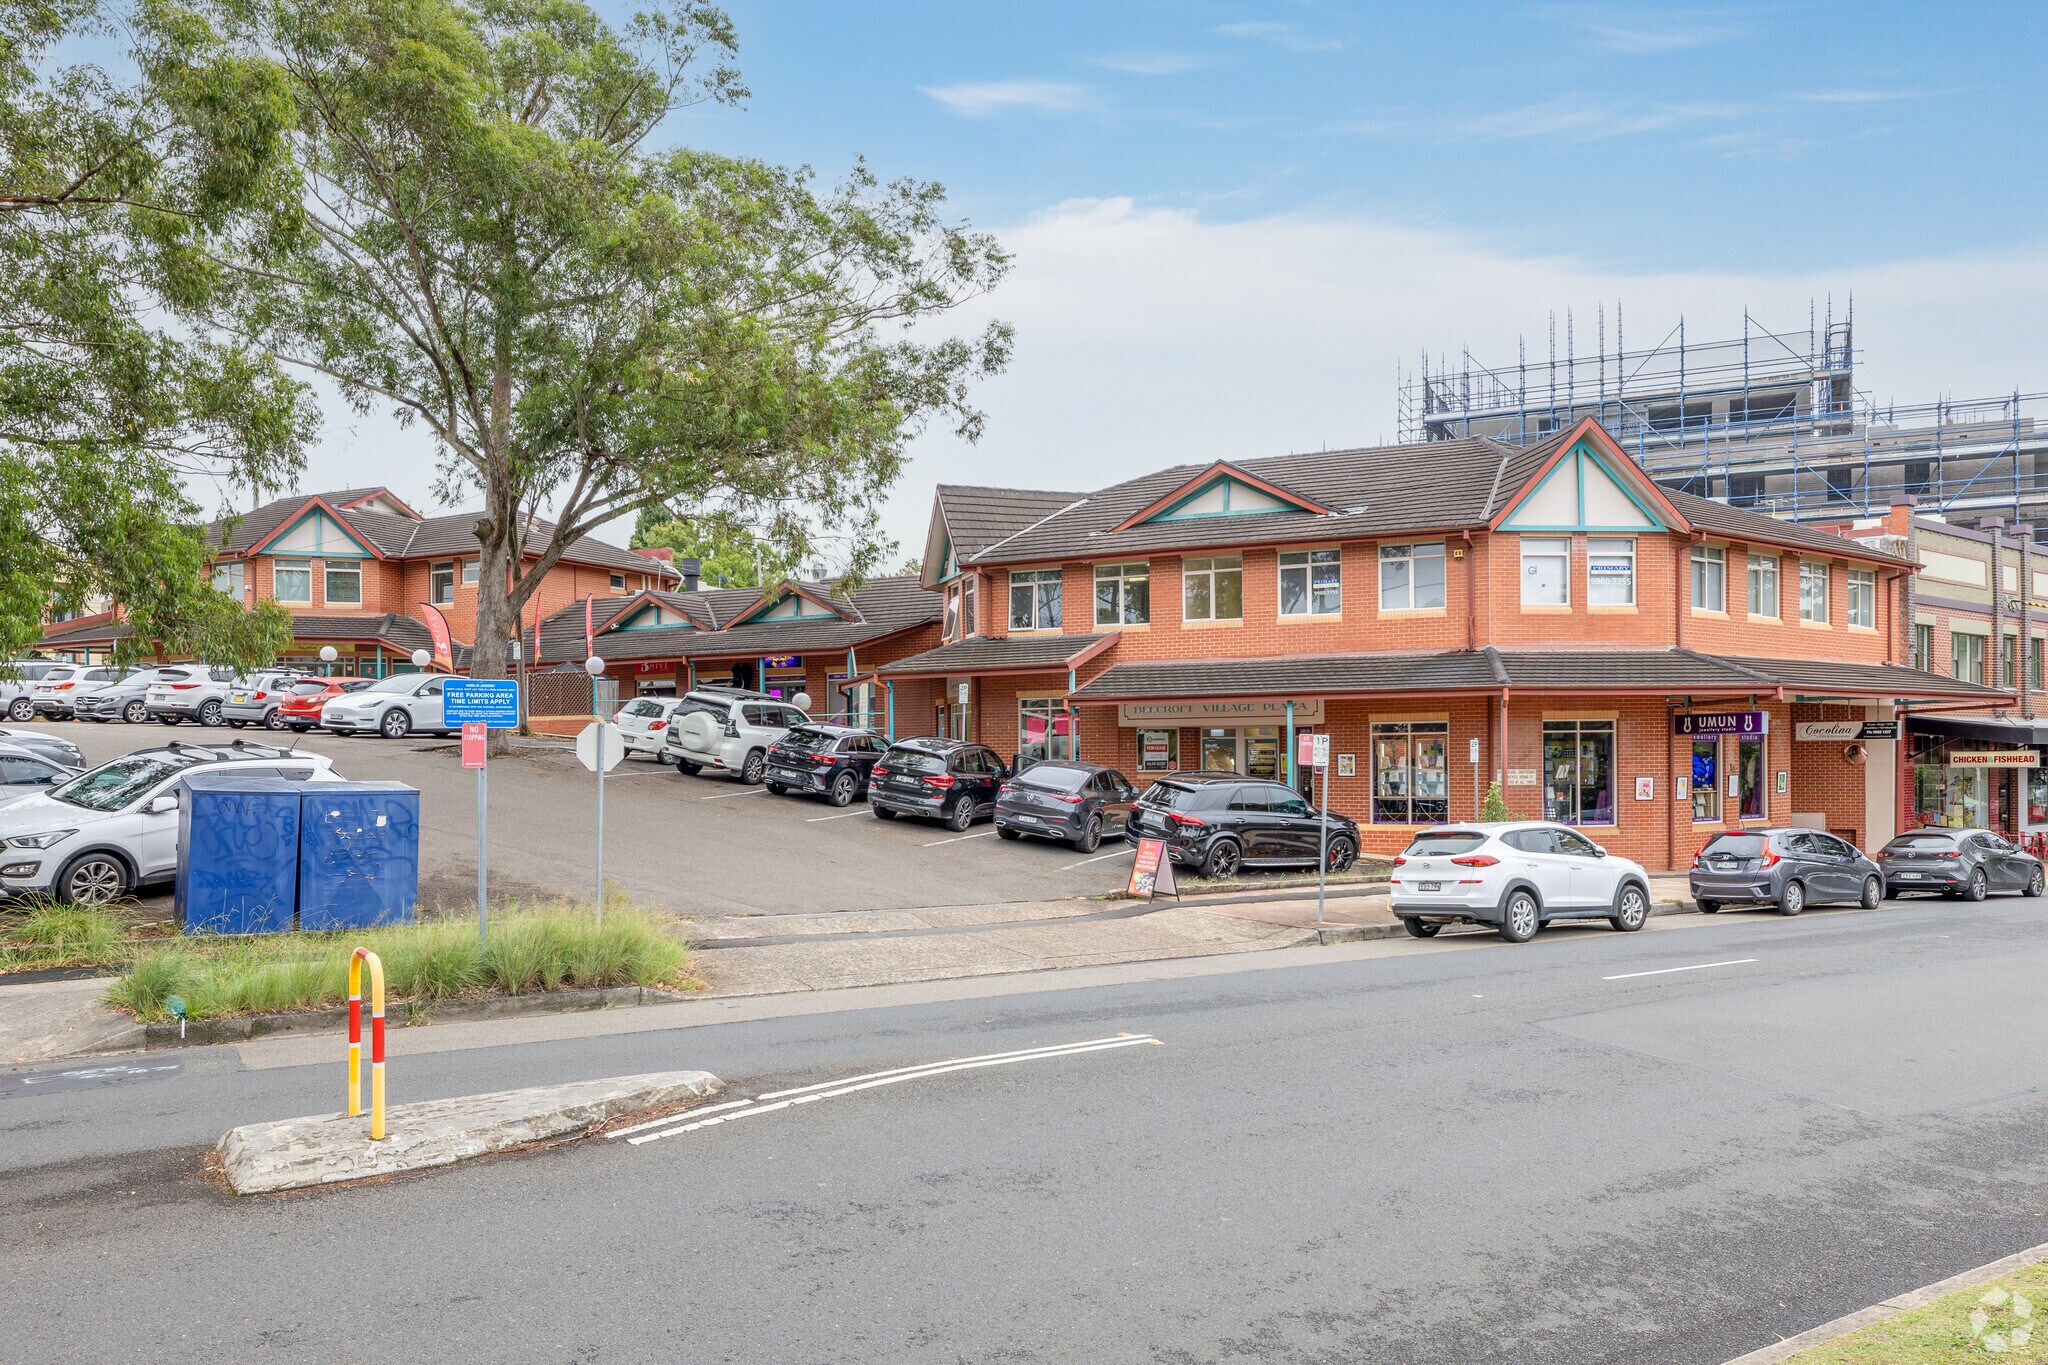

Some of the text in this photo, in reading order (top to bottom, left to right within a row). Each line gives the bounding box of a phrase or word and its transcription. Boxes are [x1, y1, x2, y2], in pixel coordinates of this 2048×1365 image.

[1612, 578, 1632, 586] 7755
[1134, 704, 1194, 714] BEECROFT
[1203, 703, 1255, 713] VILLAGE
[1698, 715, 1737, 728] UMUN
[469, 725, 479, 733] NO
[1802, 722, 1853, 736] Cocolina
[1317, 737, 1329, 745] 1P
